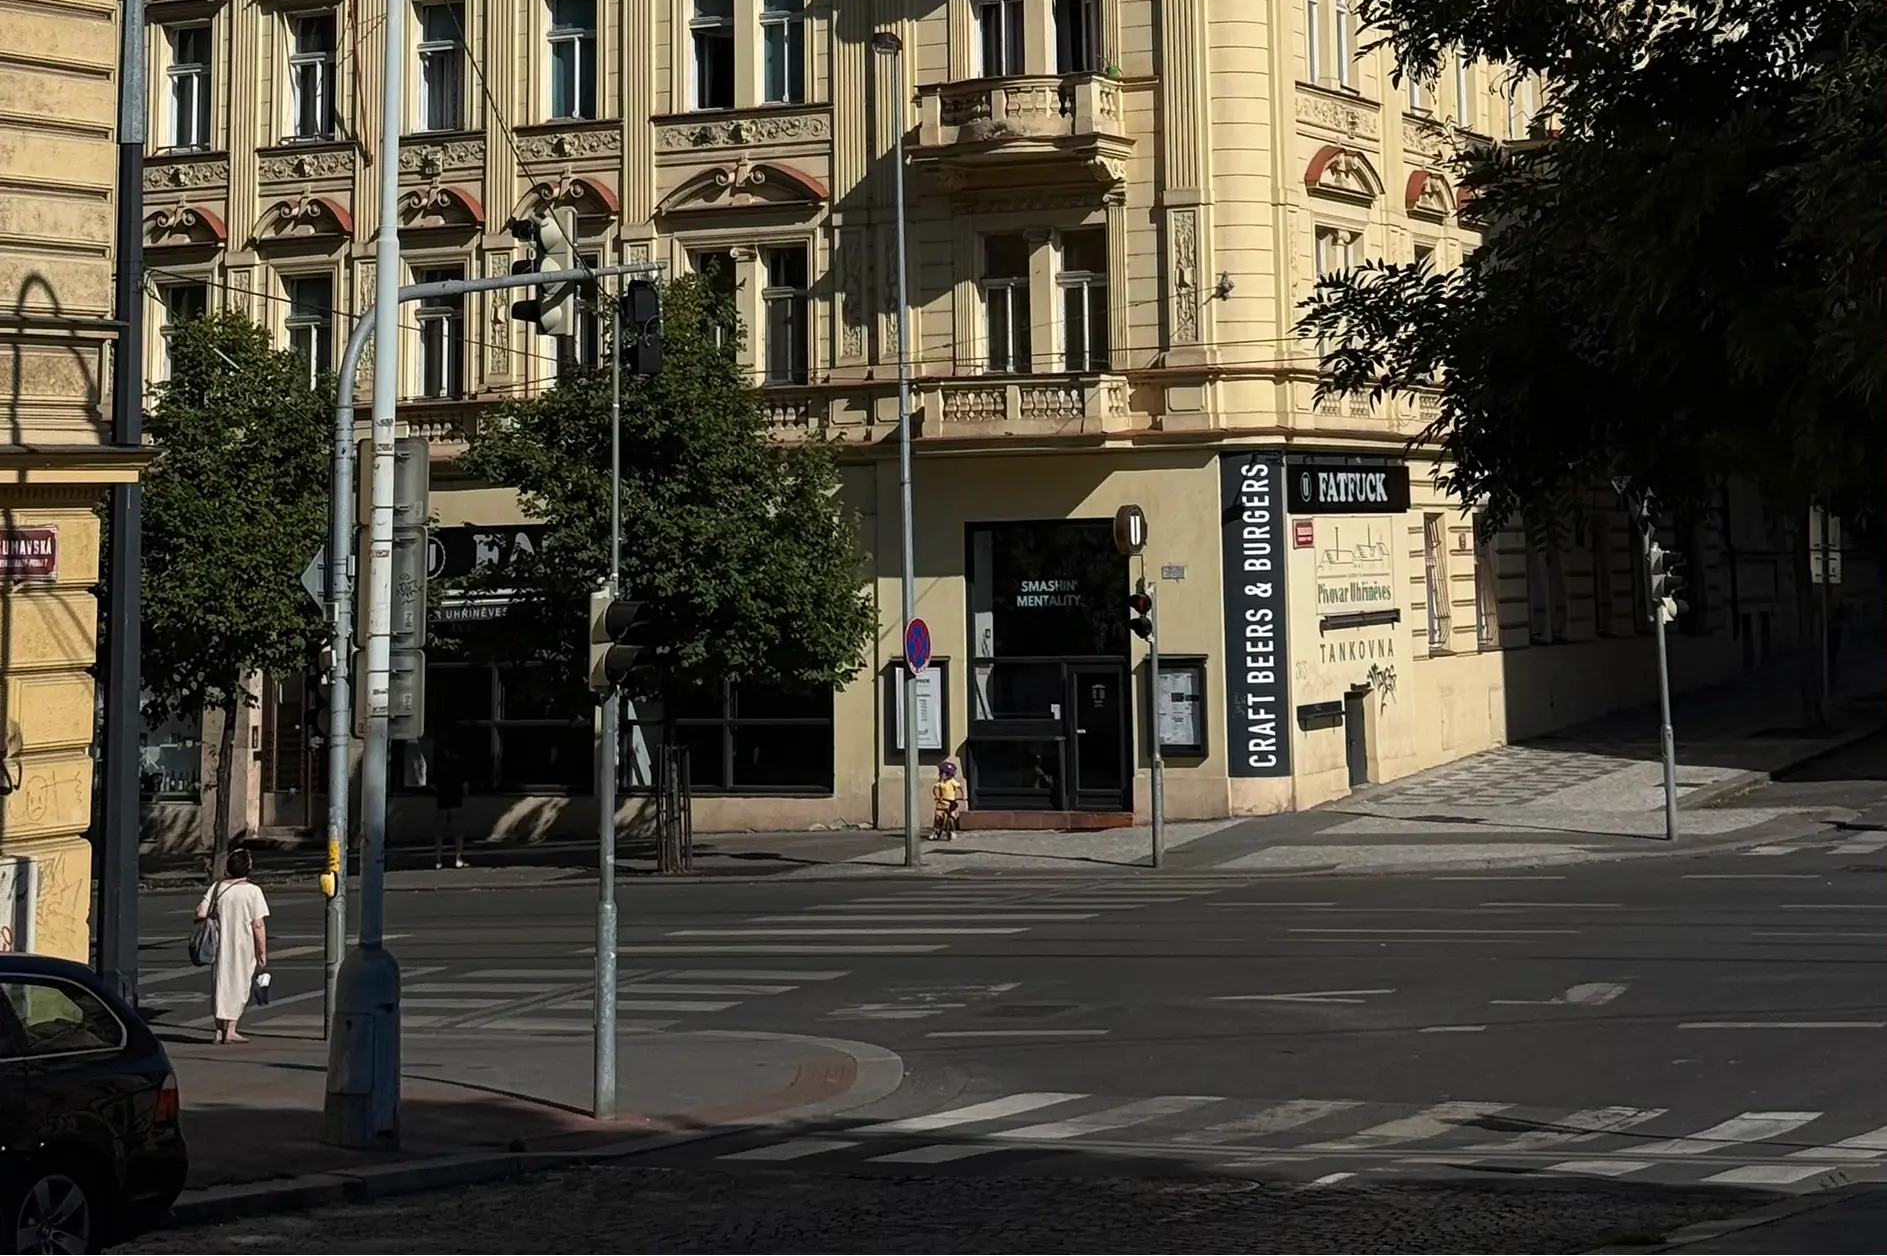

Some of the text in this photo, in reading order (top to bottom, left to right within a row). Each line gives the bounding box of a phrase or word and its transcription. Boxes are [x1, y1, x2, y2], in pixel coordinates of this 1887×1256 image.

[1318, 472, 1388, 502] FATFUCK
[0, 537, 52, 555] UMAVSKÁ
[1016, 594, 1081, 607] MENTALITY
[1317, 583, 1349, 604] Pivovar
[1241, 464, 1277, 768] CRAFT BEERS & BURGERS
[1320, 638, 1394, 664] TANKOVNA
